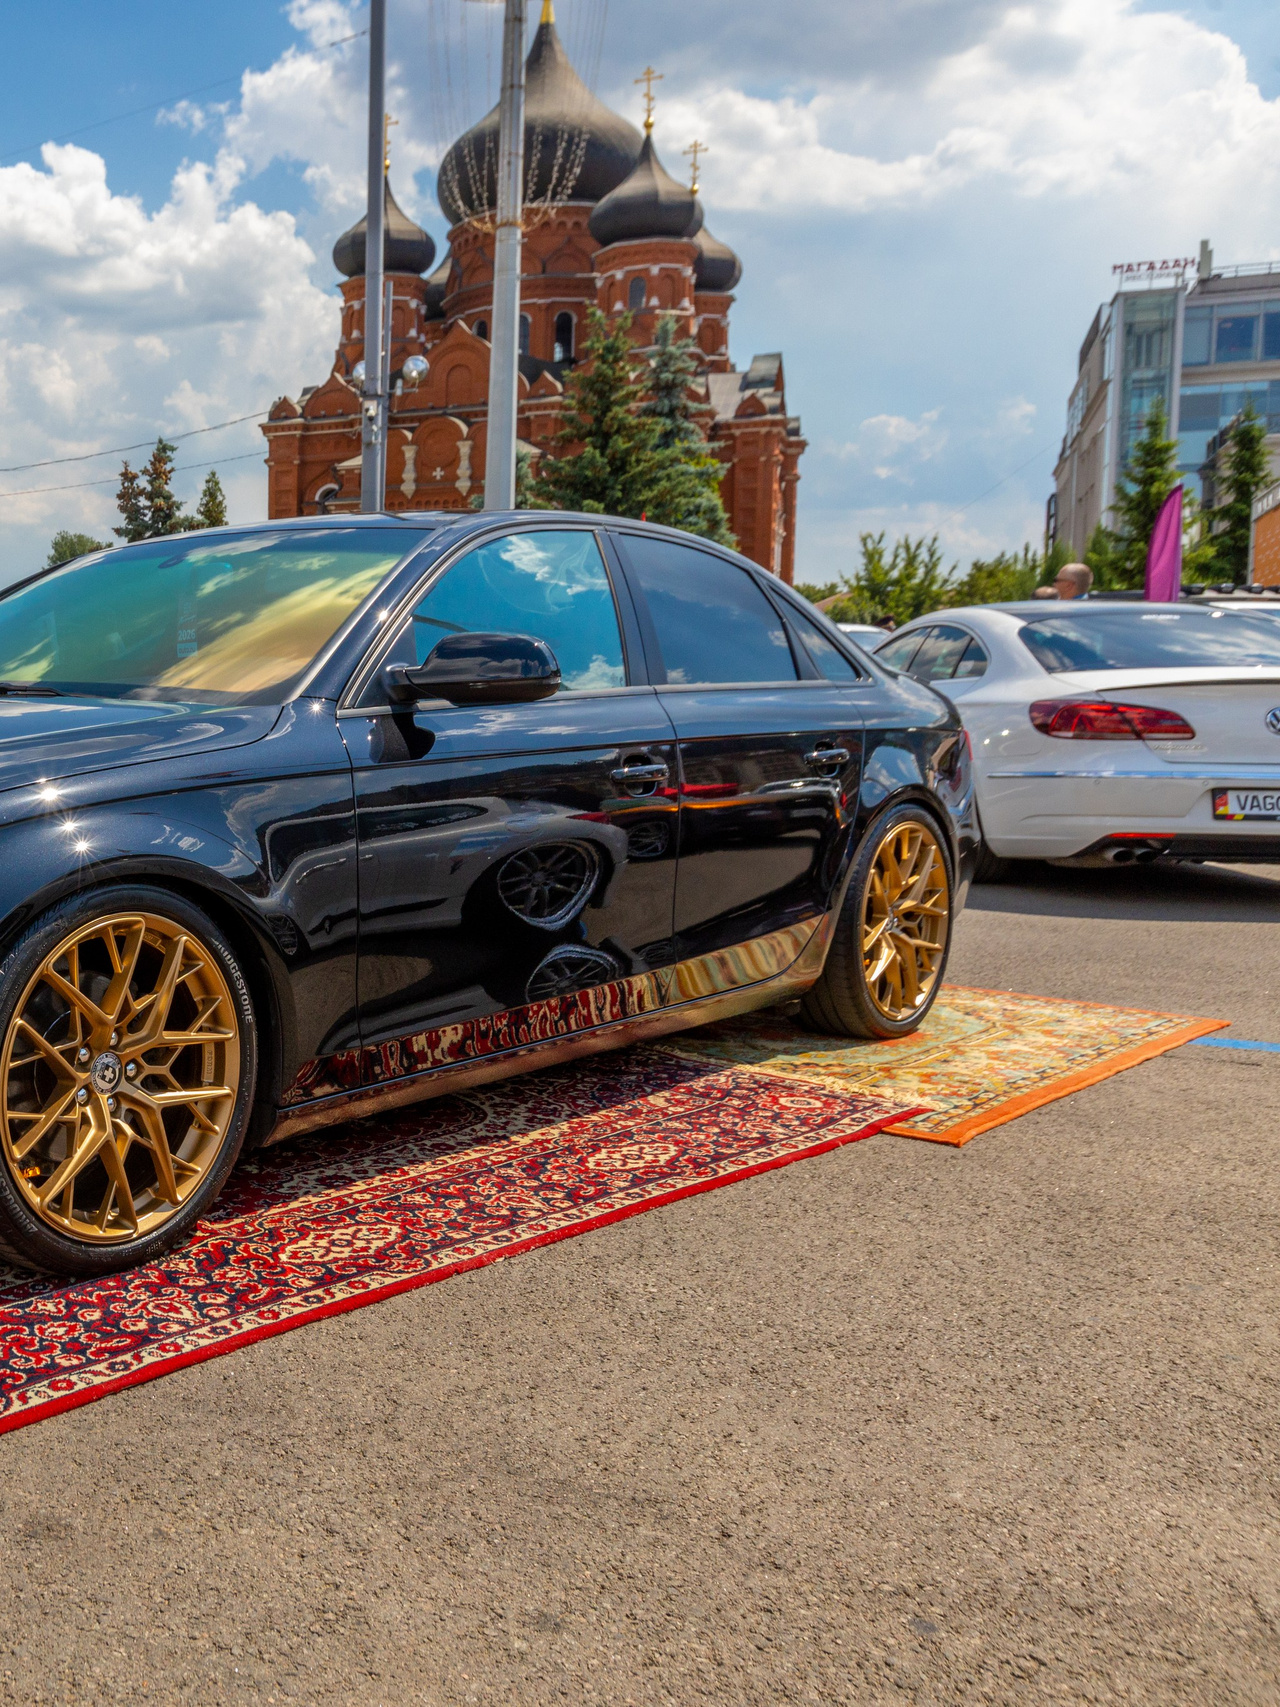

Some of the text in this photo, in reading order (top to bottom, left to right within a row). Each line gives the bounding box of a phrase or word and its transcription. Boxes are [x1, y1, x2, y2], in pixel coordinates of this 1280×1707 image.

[1112, 256, 1195, 275] МАГАДАН
[178, 629, 196, 641] 2026
[1236, 794, 1280, 811] VAG
